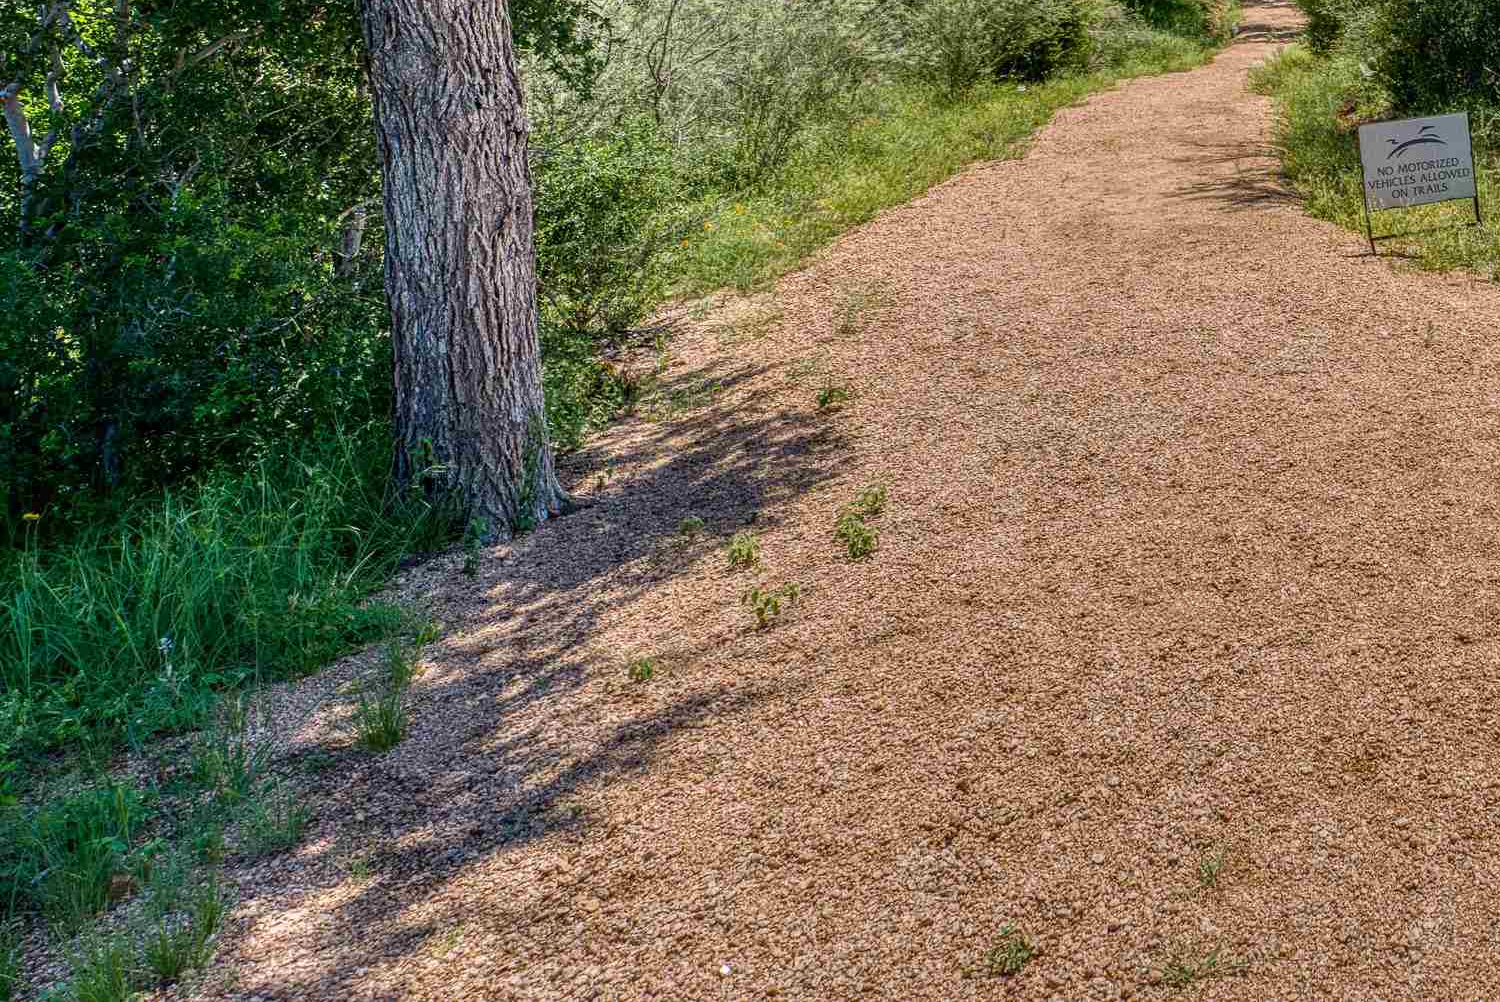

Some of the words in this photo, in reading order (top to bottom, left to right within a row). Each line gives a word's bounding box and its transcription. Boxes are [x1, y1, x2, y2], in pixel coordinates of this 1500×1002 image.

[1377, 166, 1394, 176] NO
[1399, 157, 1459, 173] MOTORIZED
[1368, 175, 1416, 190] VEHICLES
[1420, 167, 1470, 183] ALLOWED
[1391, 189, 1408, 199] ON
[1413, 184, 1449, 197] TRAILS
